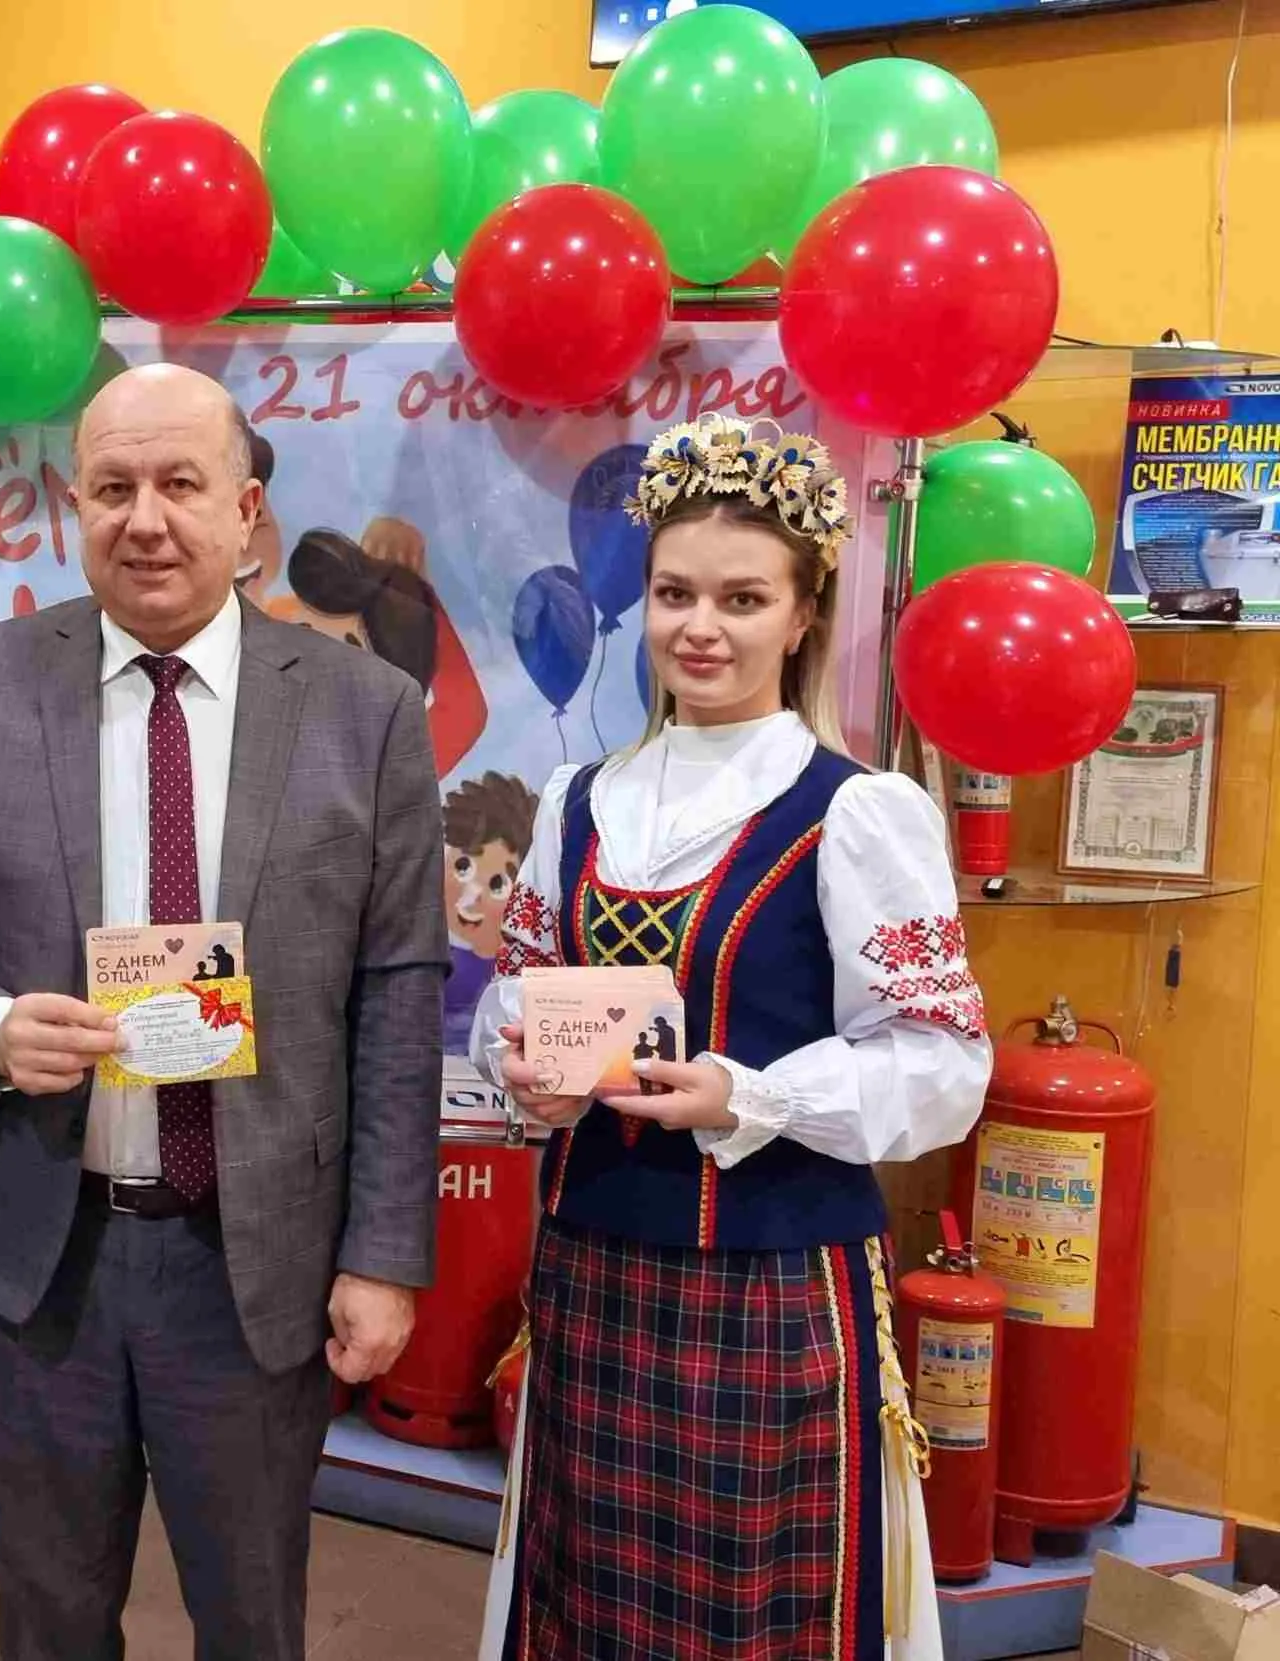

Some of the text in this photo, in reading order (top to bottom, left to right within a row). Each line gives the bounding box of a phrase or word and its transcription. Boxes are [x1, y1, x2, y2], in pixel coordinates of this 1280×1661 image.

[250, 344, 808, 425] 21 окбря
[1137, 404, 1221, 417] НОВИНКА
[1132, 462, 1248, 491] СЧЕТЧИК
[96, 954, 166, 969] С ДНЕМ
[96, 970, 150, 984] ОТЦА!
[539, 1019, 608, 1034] С ДНЕМ
[539, 1034, 592, 1048] ОТЦА!
[439, 1164, 492, 1199] АН
